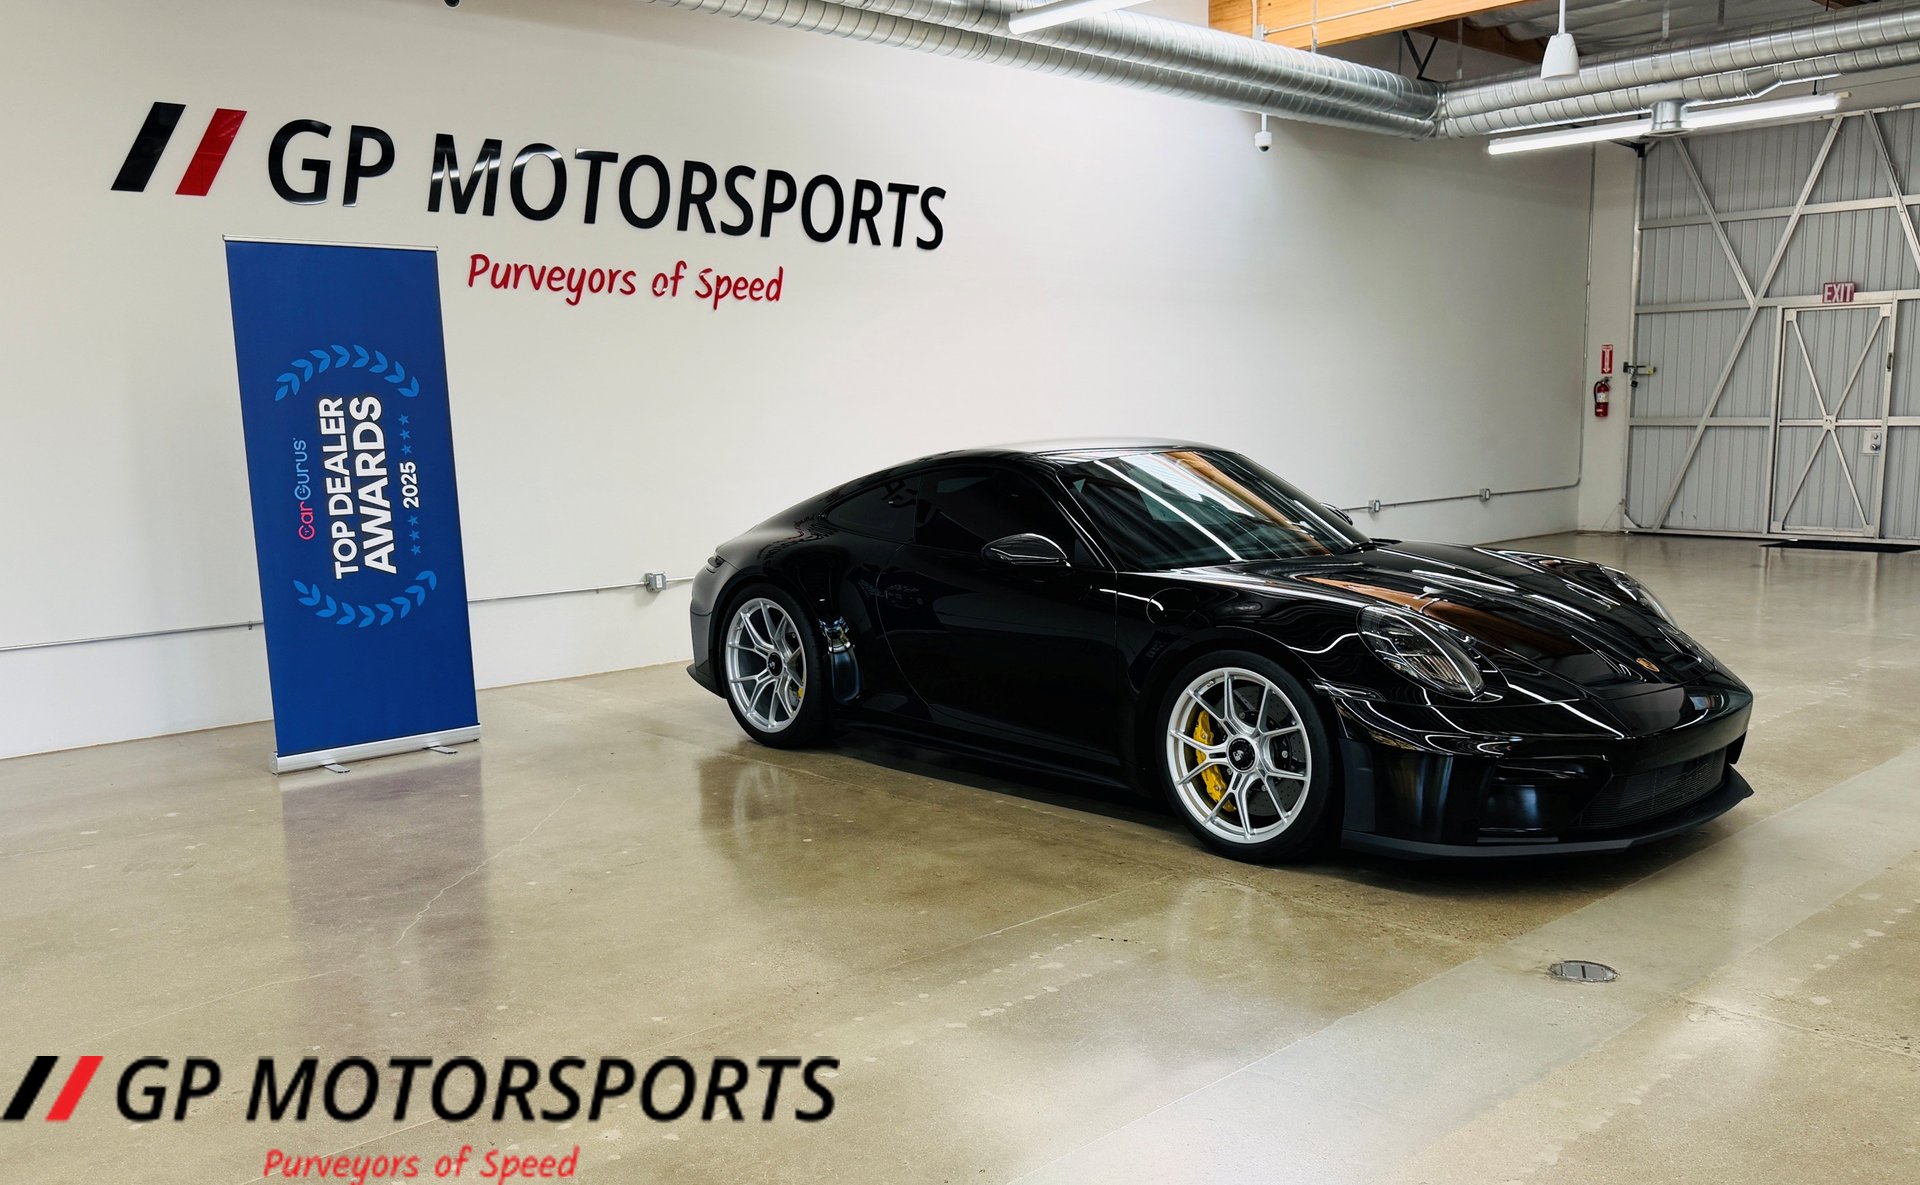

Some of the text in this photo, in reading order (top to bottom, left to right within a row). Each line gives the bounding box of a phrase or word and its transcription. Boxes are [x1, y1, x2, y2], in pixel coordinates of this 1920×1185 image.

[268, 119, 947, 250] GP MOTORSPORTS
[468, 254, 784, 310] Purveyors of Speed
[1824, 283, 1854, 303] EXIT
[318, 397, 359, 579] TOP DEALER
[350, 396, 397, 574] AWARDS
[400, 461, 420, 508] 2025
